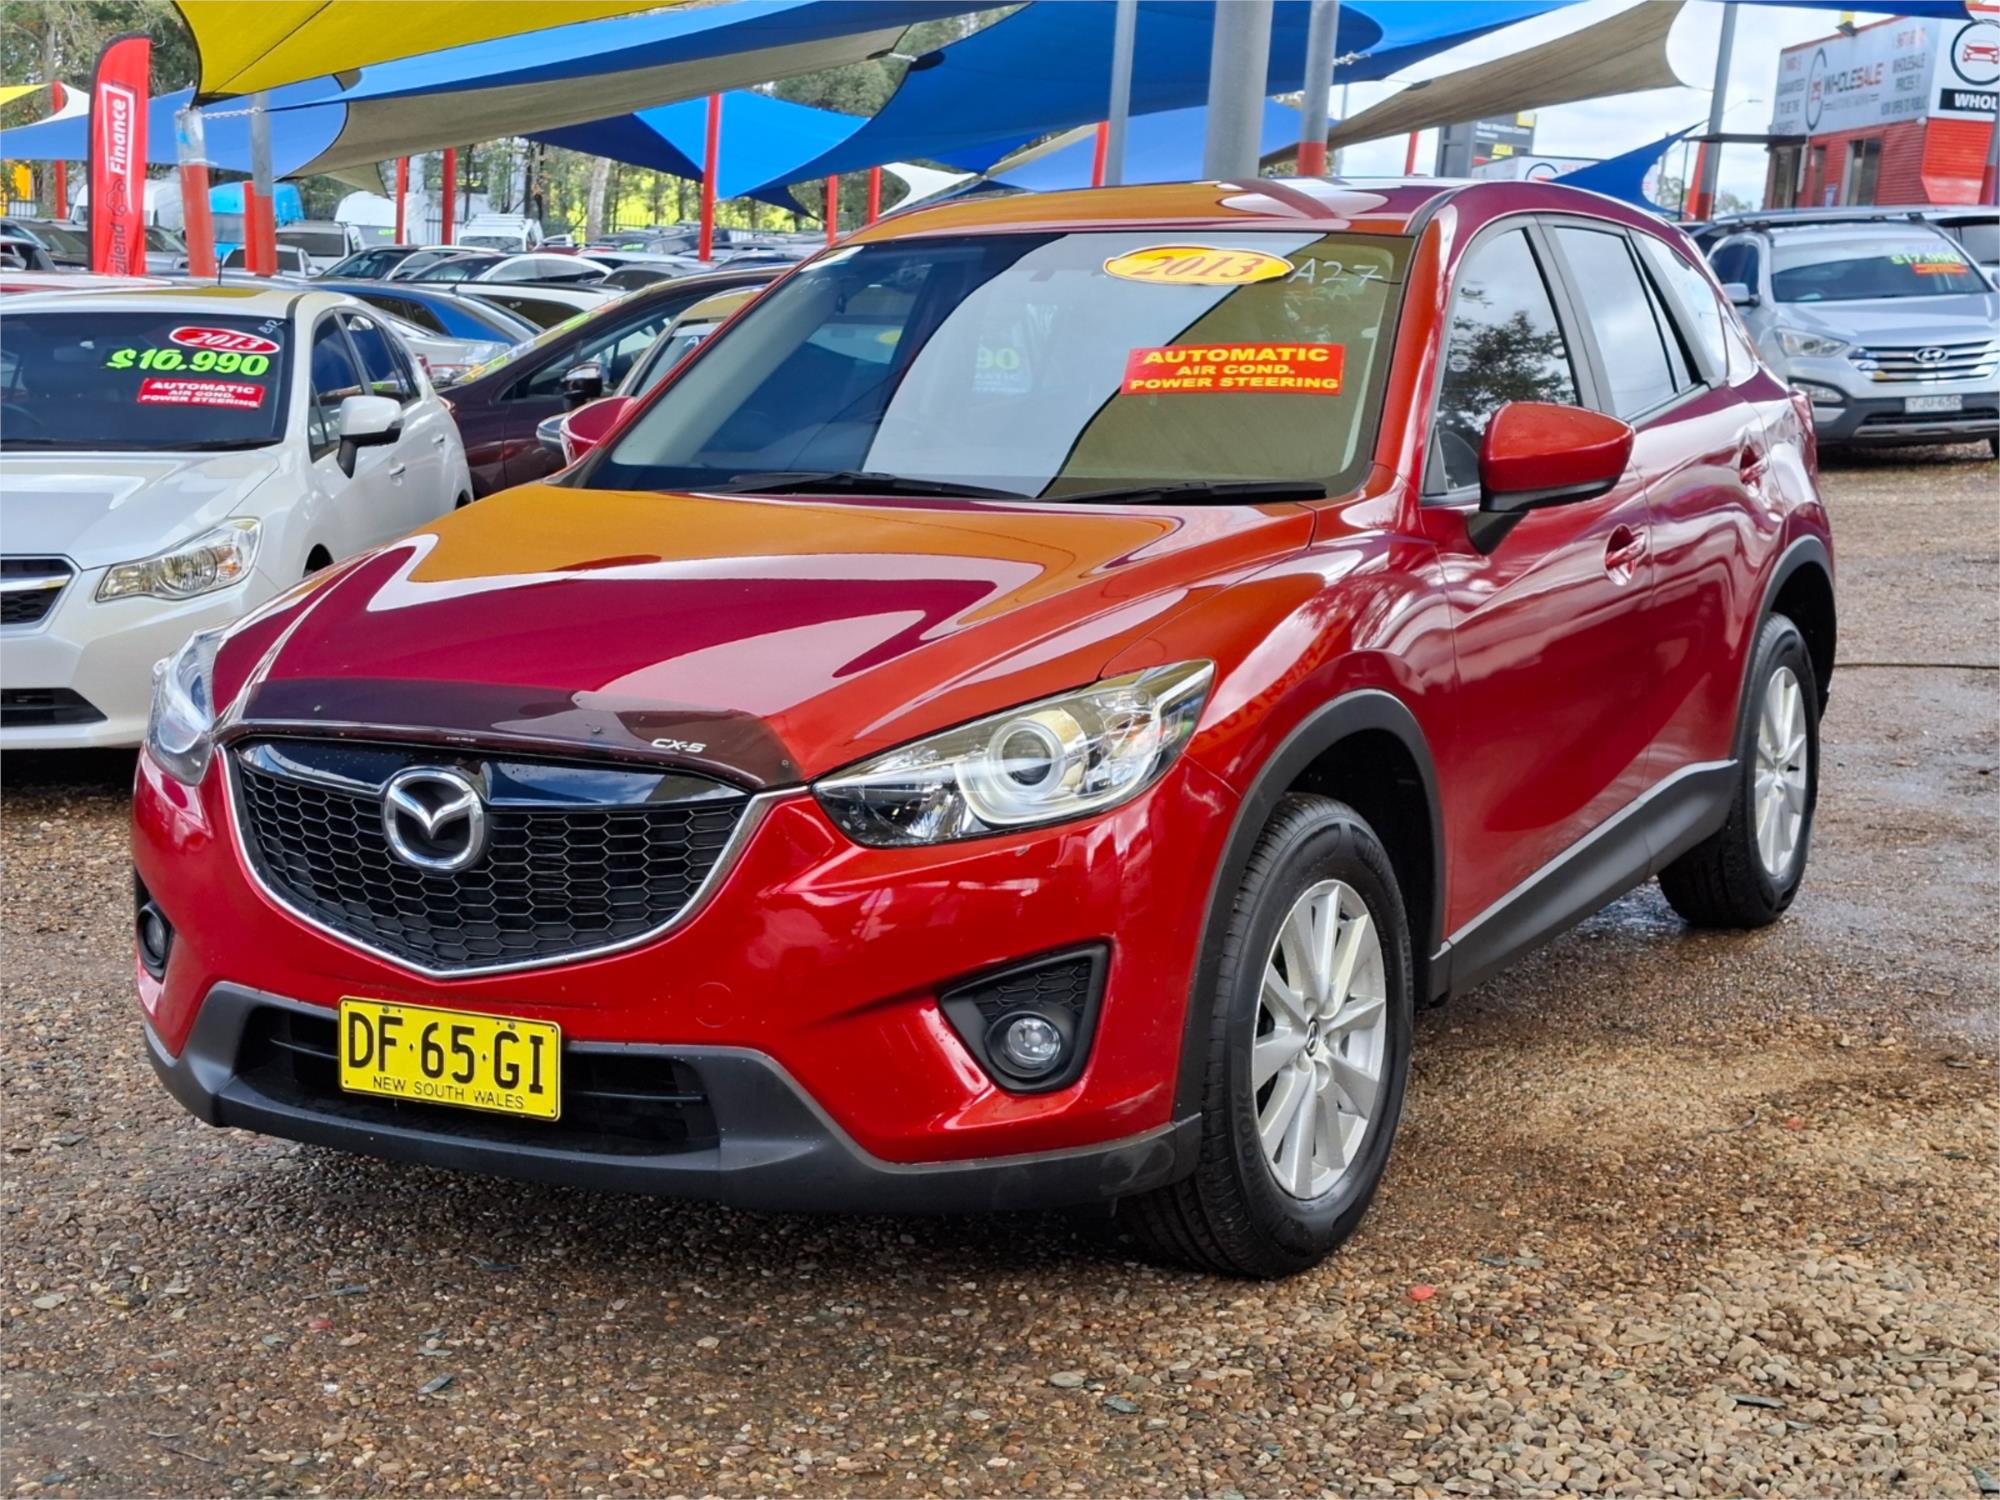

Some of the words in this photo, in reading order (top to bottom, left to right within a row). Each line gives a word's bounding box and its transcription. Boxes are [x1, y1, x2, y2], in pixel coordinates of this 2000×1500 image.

[1954, 92, 1998, 110] WHOL
[109, 98, 127, 176] Finance
[1132, 254, 1265, 278] 2013
[1288, 257, 1384, 287] A27
[183, 332, 267, 350] 2013
[1142, 347, 1330, 365] AUTOMATIC
[1175, 364, 1216, 376] AIR
[1222, 363, 1295, 376] COND.
[149, 381, 256, 395] AUTOMATIC
[1129, 376, 1213, 391] POWER
[1218, 376, 1340, 390] STEERING
[141, 394, 189, 402] POWER
[167, 389, 192, 397] AIR
[651, 738, 707, 753] CX-5
[373, 1076, 407, 1092] NEW
[414, 1081, 465, 1101] SOUTH
[473, 1089, 524, 1109] WALES
